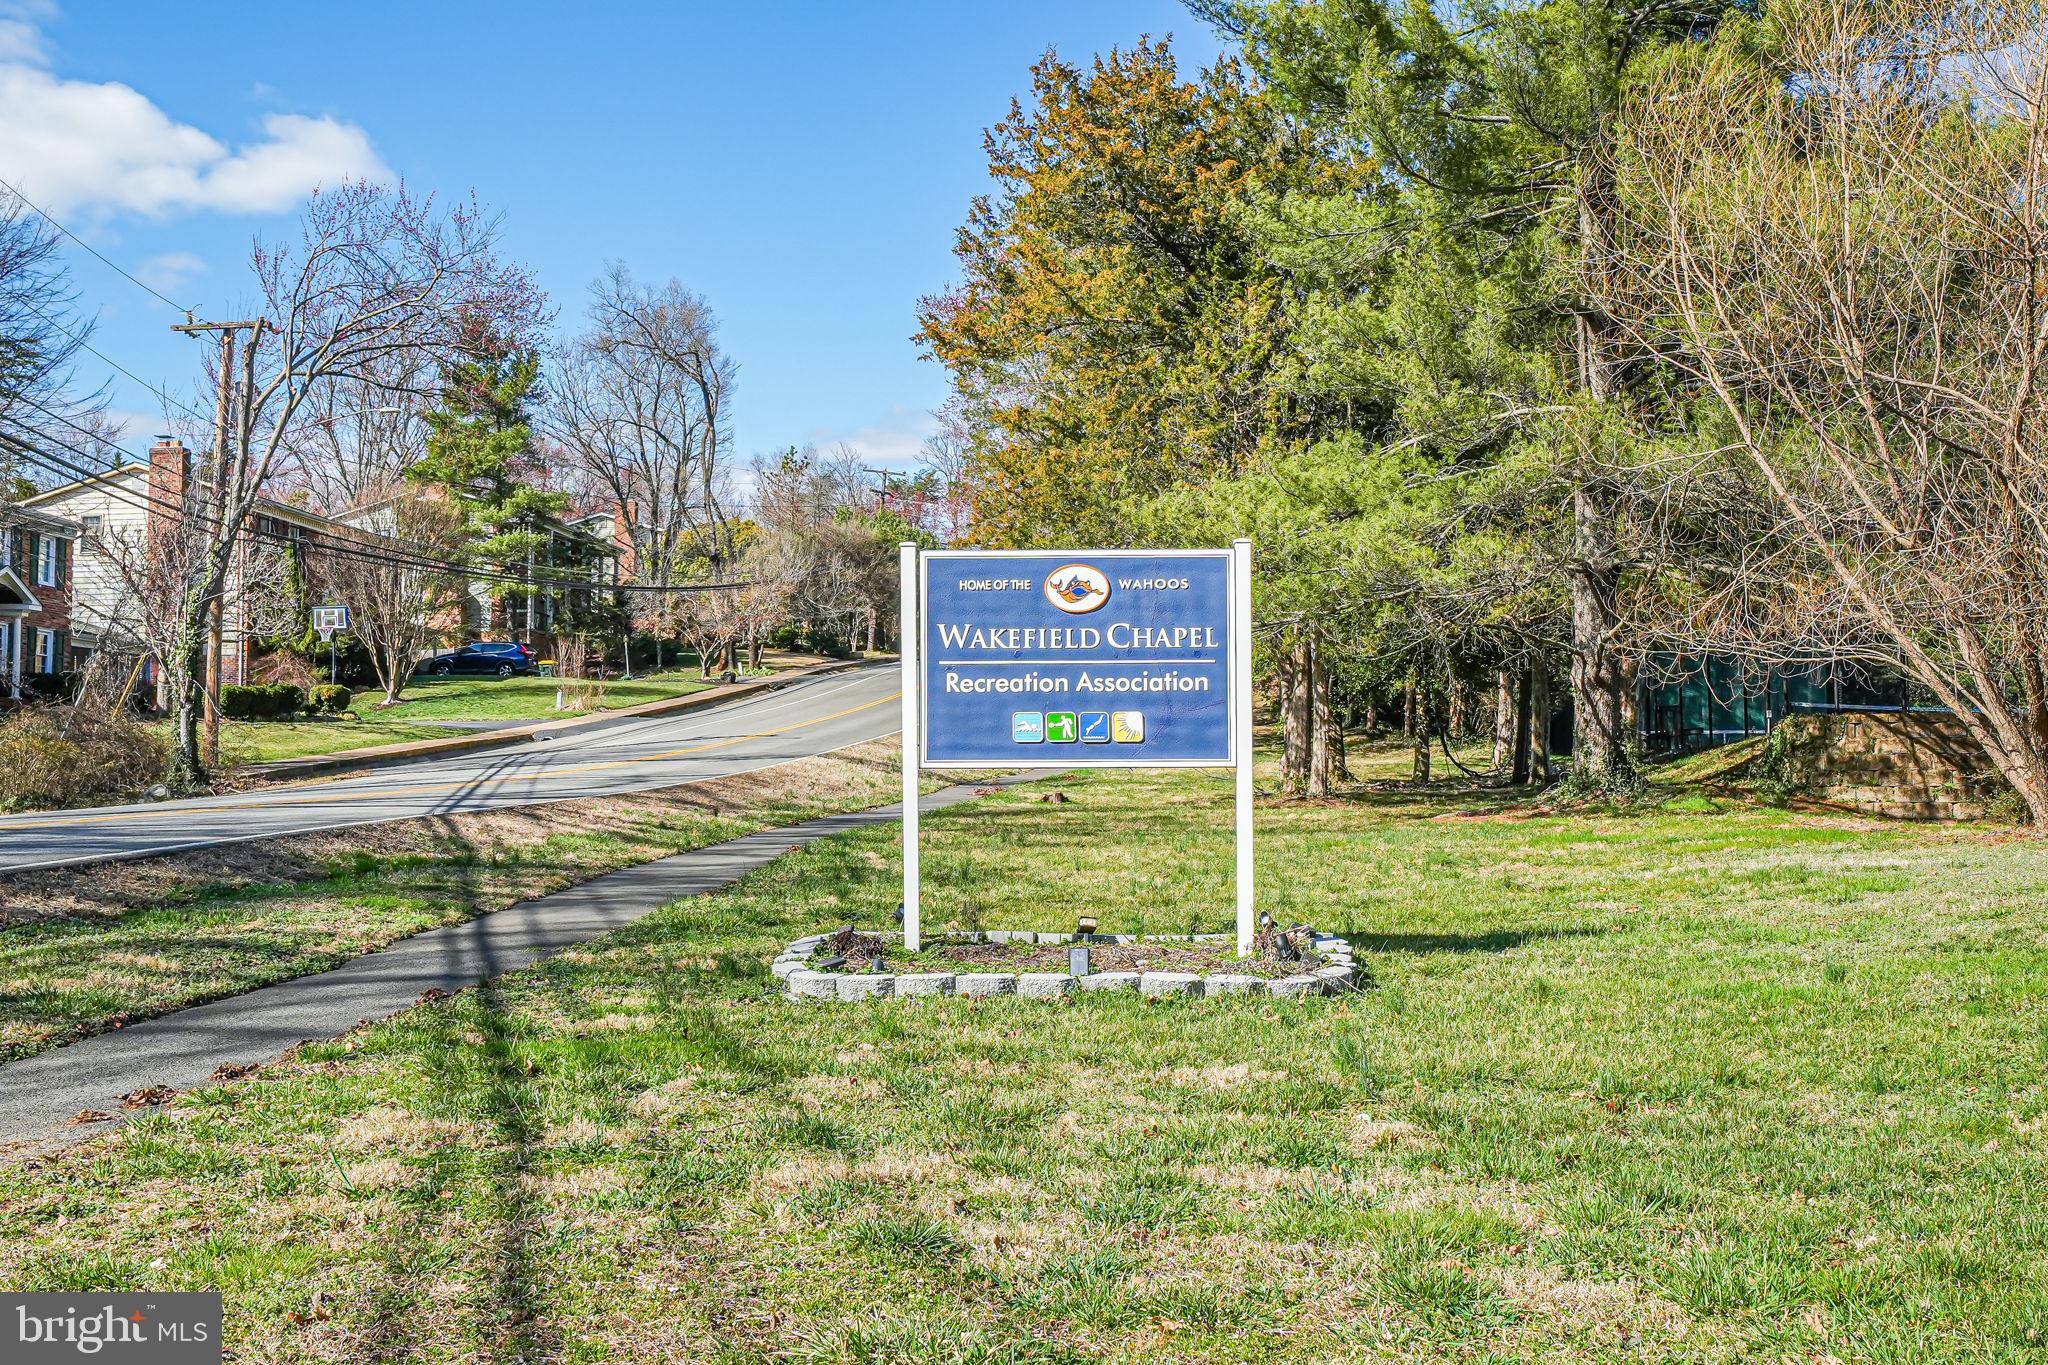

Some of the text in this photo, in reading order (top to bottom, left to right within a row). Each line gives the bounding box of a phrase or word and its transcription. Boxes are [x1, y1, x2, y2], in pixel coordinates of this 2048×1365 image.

[959, 578, 1189, 591] HOME OF THE WAHOOS
[937, 622, 1219, 650] WAKEFIELD CHAPEL
[946, 671, 1209, 693] Recreation Association
